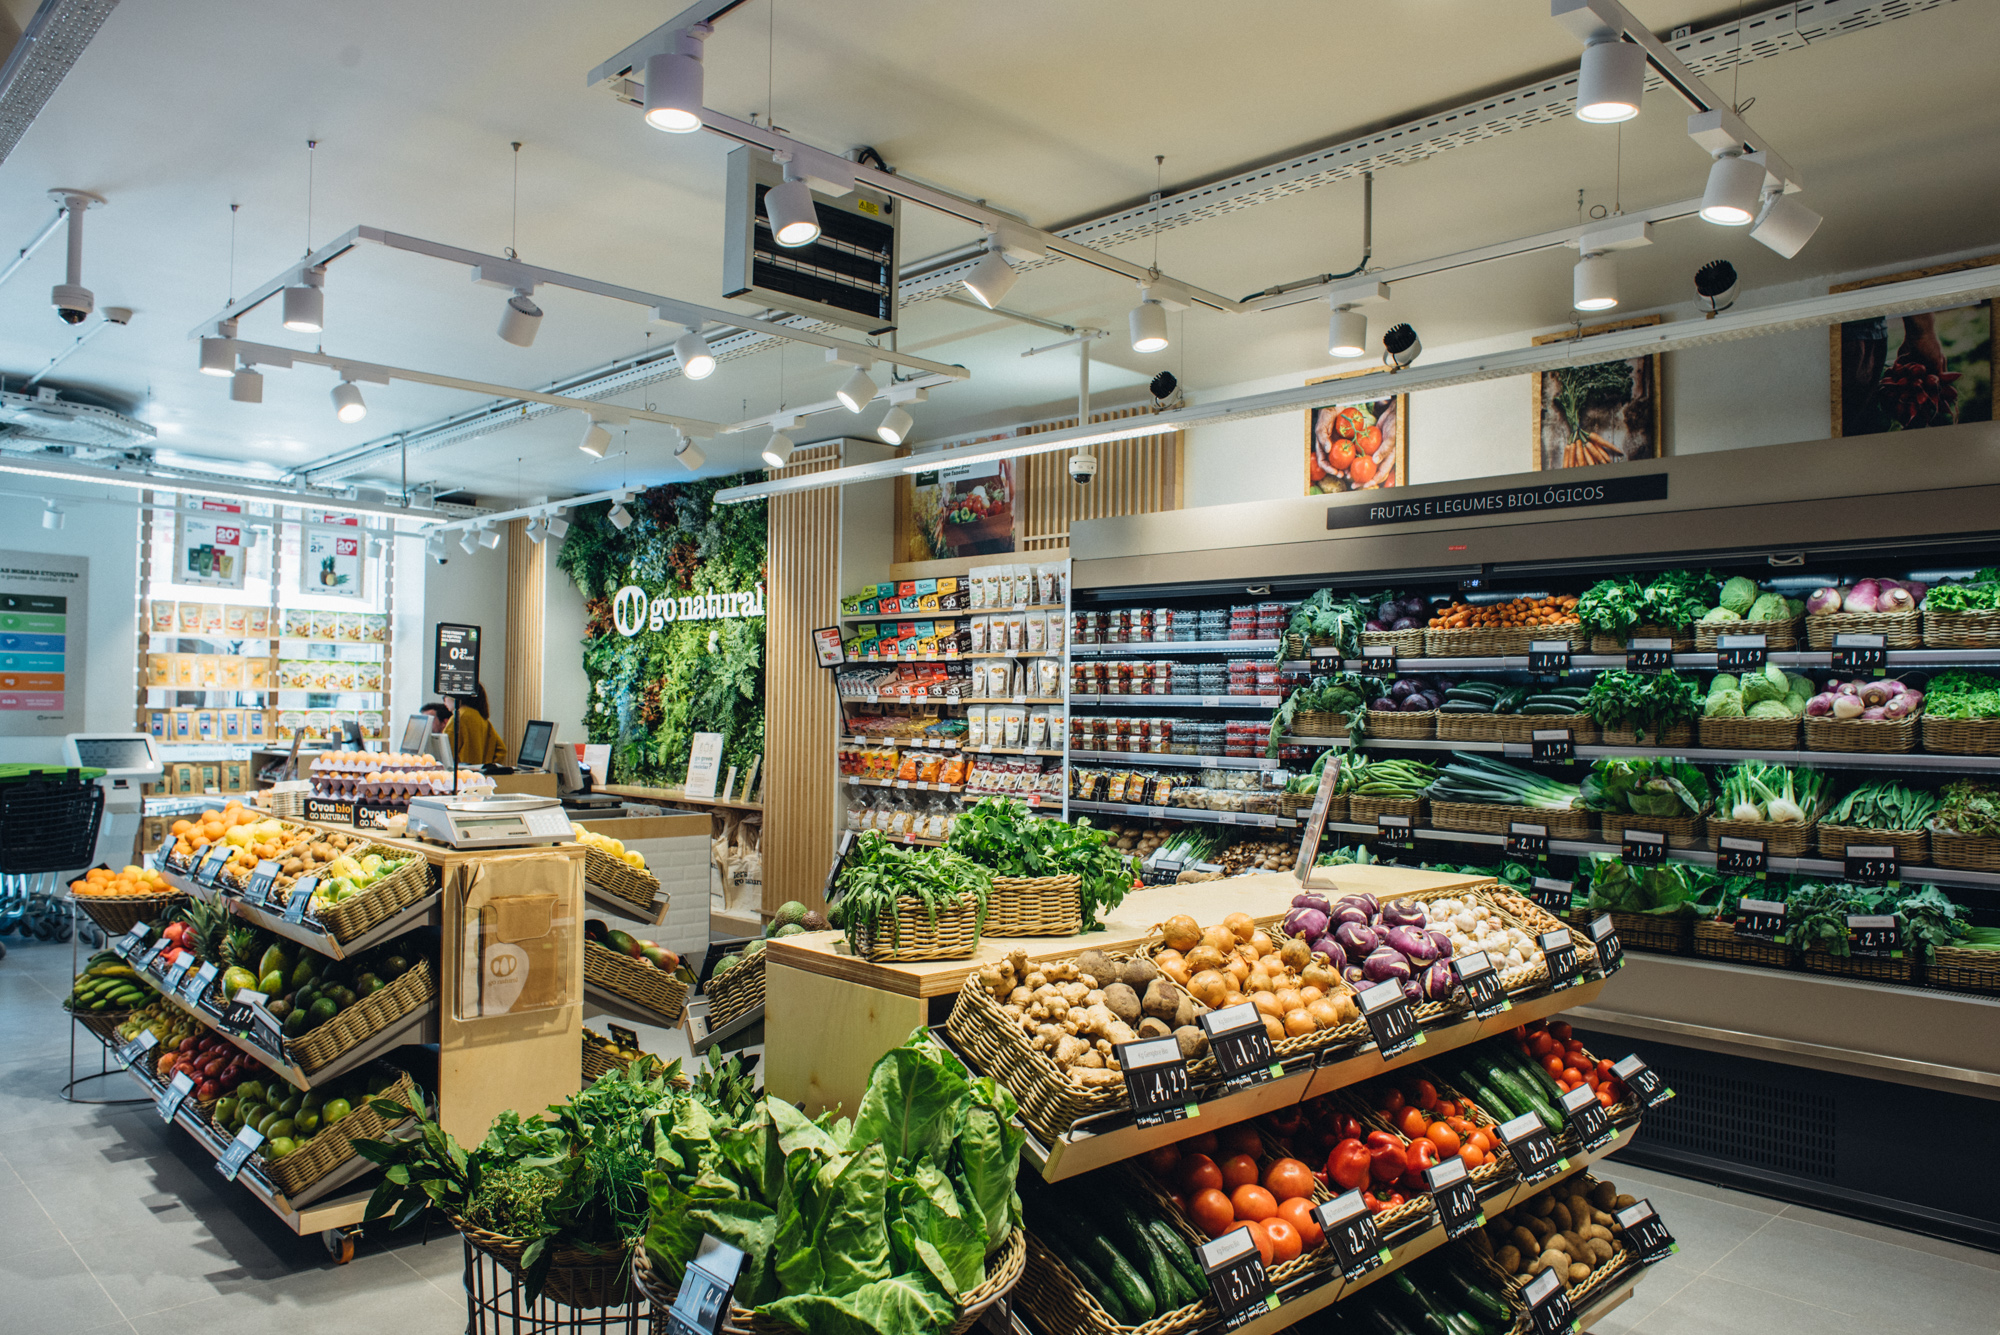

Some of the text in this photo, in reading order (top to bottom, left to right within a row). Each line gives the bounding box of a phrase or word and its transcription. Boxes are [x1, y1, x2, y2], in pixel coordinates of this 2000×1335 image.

[1370, 486, 1605, 520] FRUTAS E LEGUMES BIOLÓGICOS
[650, 582, 765, 632] go natural
[1538, 655, 1567, 668] €1,49
[1637, 652, 1668, 666] €2,99
[1729, 650, 1762, 665] €1,69
[1844, 650, 1881, 665] €1,99
[1542, 743, 1568, 757] €1,99
[309, 801, 351, 814] Ovos bio
[309, 812, 350, 822] GO NATURAL
[1632, 844, 1662, 859] €1,99
[1729, 853, 1761, 867] €3,09
[1859, 861, 1896, 877] €5,99
[1860, 931, 1896, 947] €2,79
[1478, 974, 1502, 1002] €1,99
[1386, 1004, 1415, 1039] €1,15
[1236, 1034, 1271, 1067] €1,59
[1150, 1068, 1187, 1103] €4,29
[1584, 1105, 1608, 1134] €3,19
[1527, 1137, 1556, 1165] €2,99
[1452, 1183, 1476, 1217] €4,09
[1348, 1217, 1377, 1256] €2,49
[1641, 1222, 1668, 1249] €1,20
[1231, 1260, 1265, 1302] €3,19
[1547, 1293, 1571, 1331] €1,99
